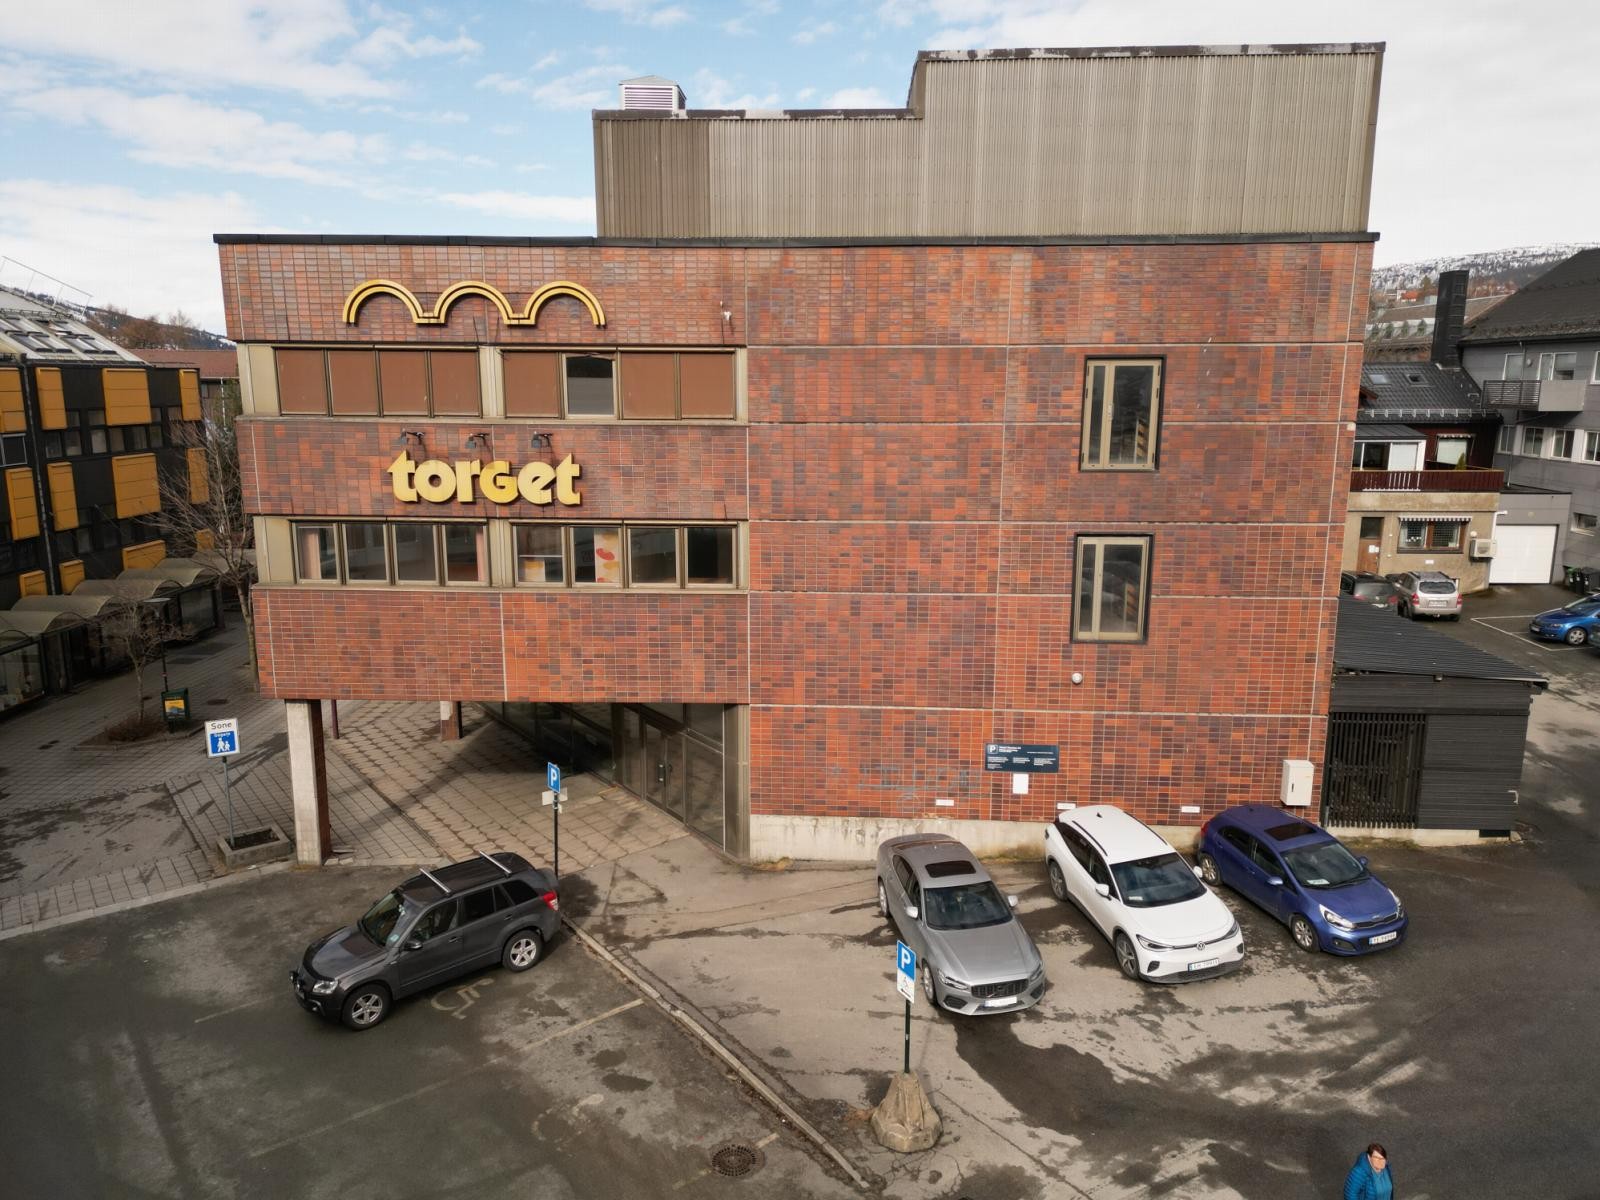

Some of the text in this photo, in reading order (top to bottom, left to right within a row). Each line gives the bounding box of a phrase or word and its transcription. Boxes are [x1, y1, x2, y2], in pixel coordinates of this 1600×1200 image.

[211, 722, 232, 730] Sone
[550, 767, 557, 787] P
[901, 946, 911, 969] P
